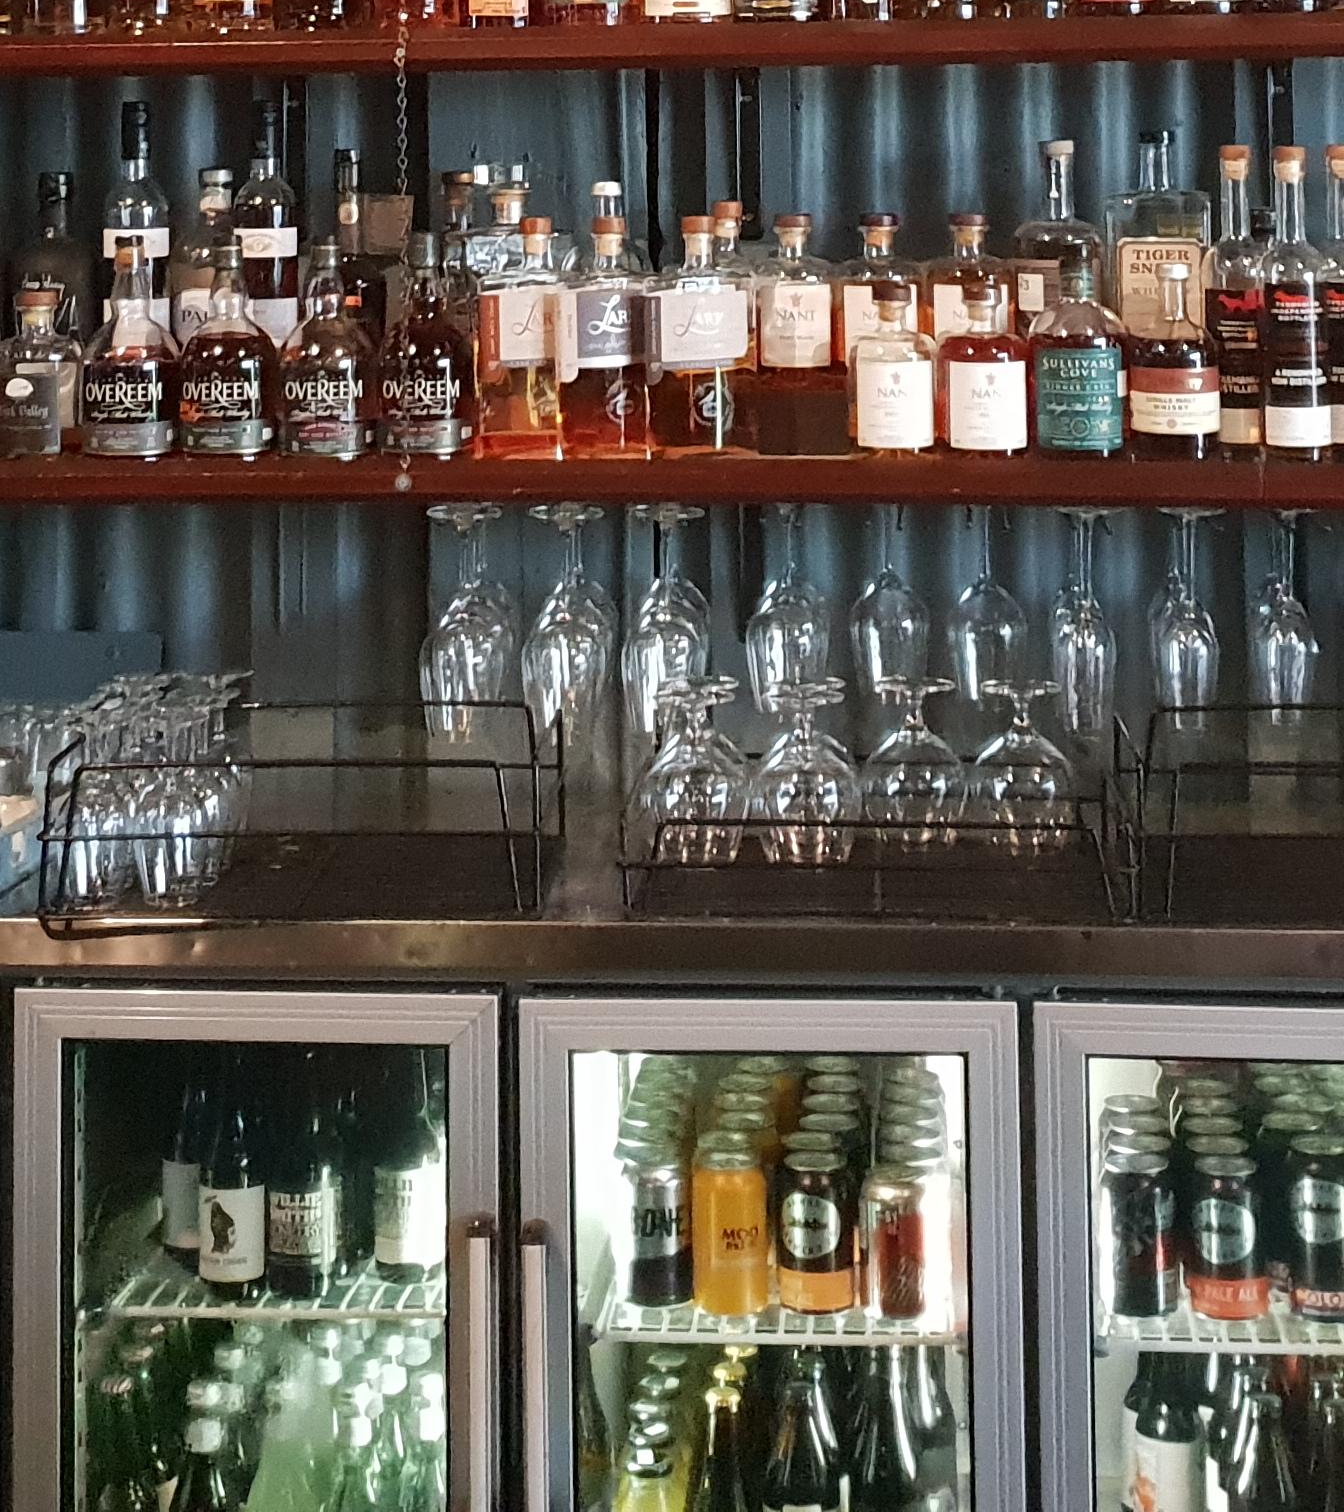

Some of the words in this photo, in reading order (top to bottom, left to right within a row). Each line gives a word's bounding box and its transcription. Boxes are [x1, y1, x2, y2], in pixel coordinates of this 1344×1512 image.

[1132, 248, 1190, 261] TIGER
[1042, 357, 1115, 370] SULLIVANS
[1059, 369, 1098, 379] COVE
[86, 381, 163, 403] OVEREEM
[183, 381, 259, 403] OVEREEM
[285, 381, 363, 403] OVEREEM
[382, 381, 460, 403] OVEREEM
